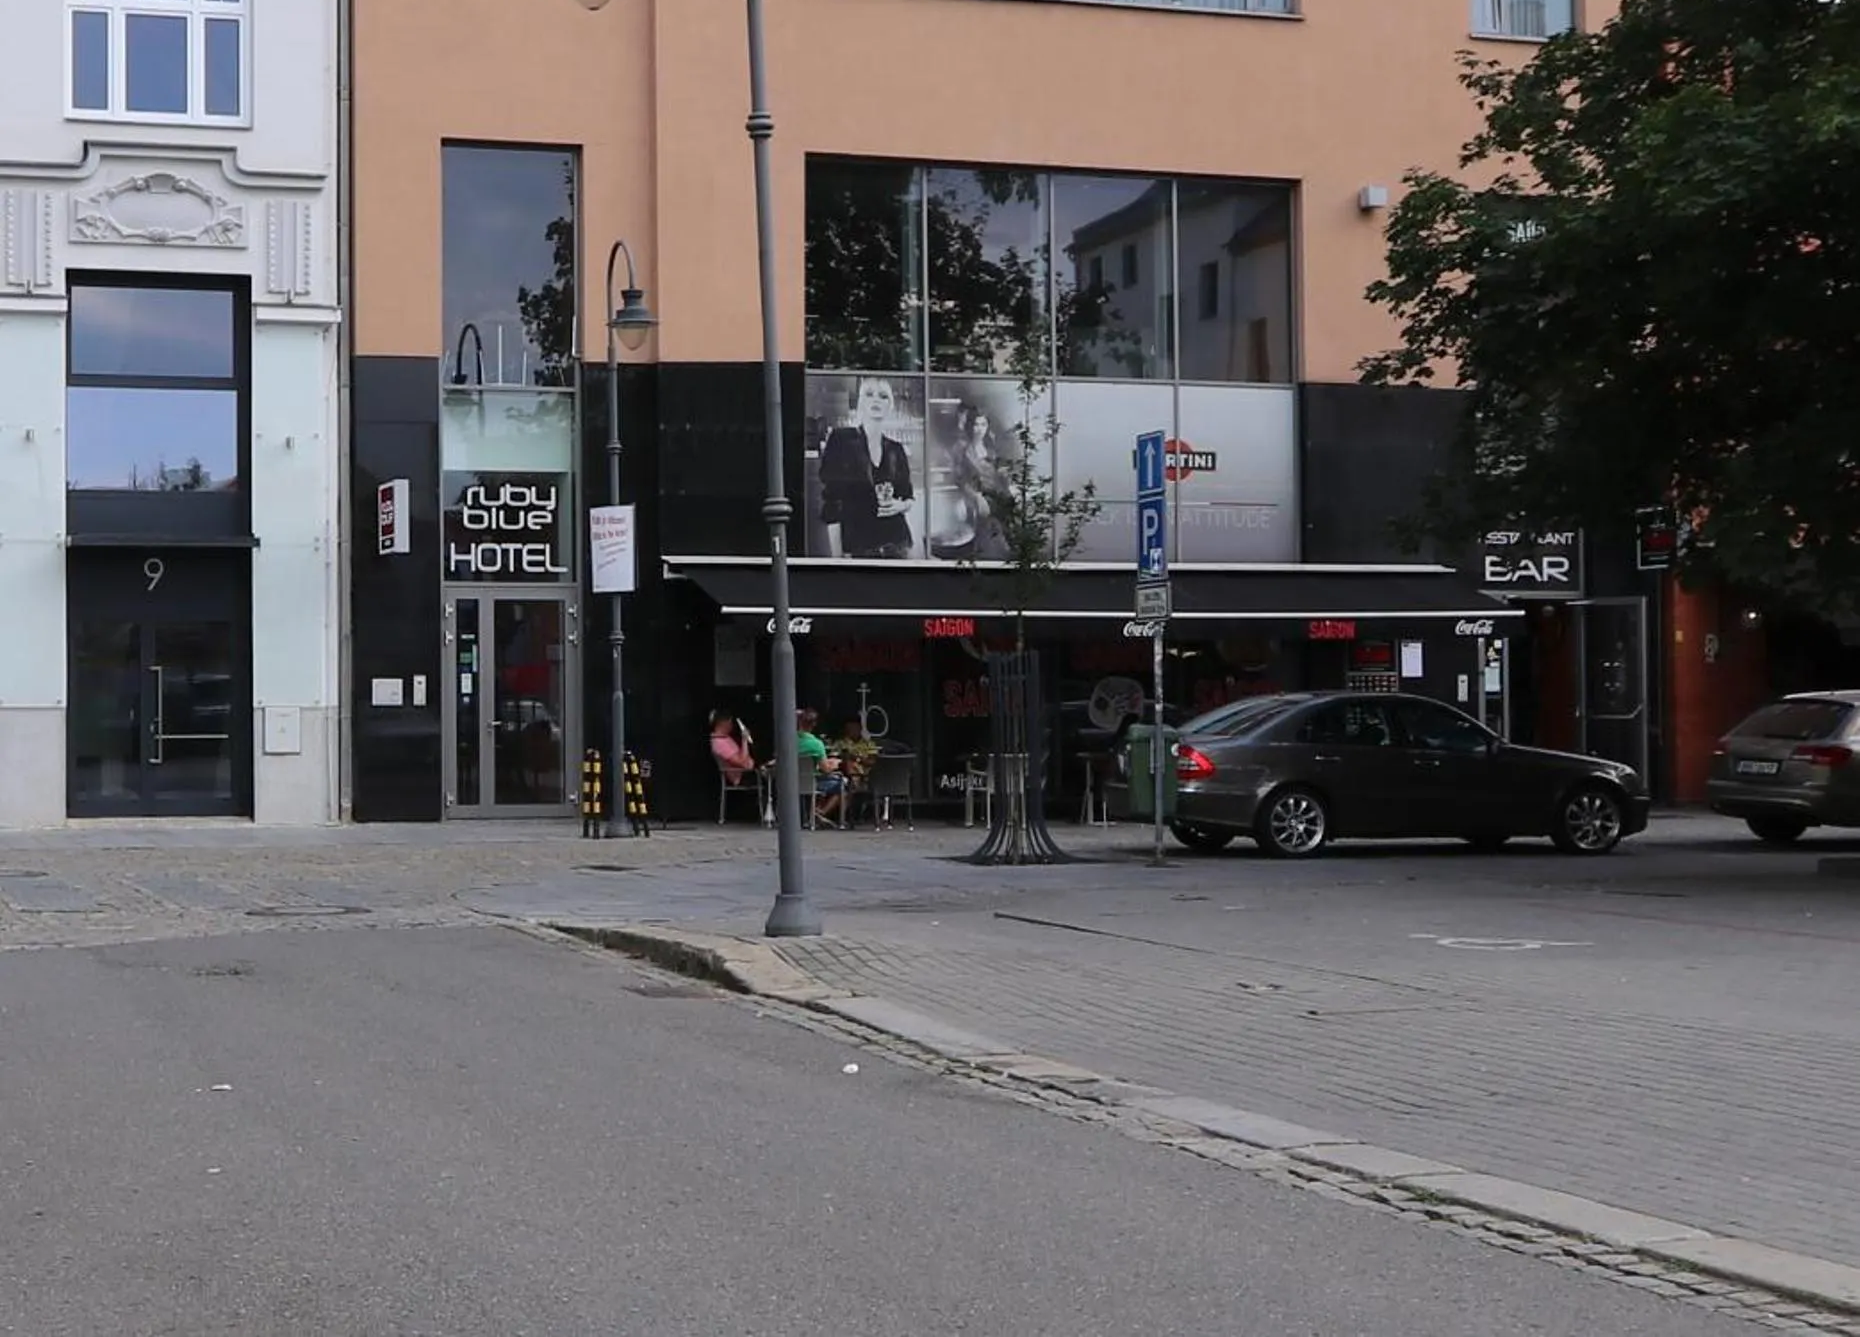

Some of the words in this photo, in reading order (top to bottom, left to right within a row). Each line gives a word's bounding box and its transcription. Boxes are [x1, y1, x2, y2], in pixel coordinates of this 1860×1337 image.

[1166, 453, 1213, 468] RTINI
[467, 483, 556, 510] ruby
[463, 506, 552, 530] blue
[450, 542, 568, 573] HOTEL
[144, 558, 164, 591] 9
